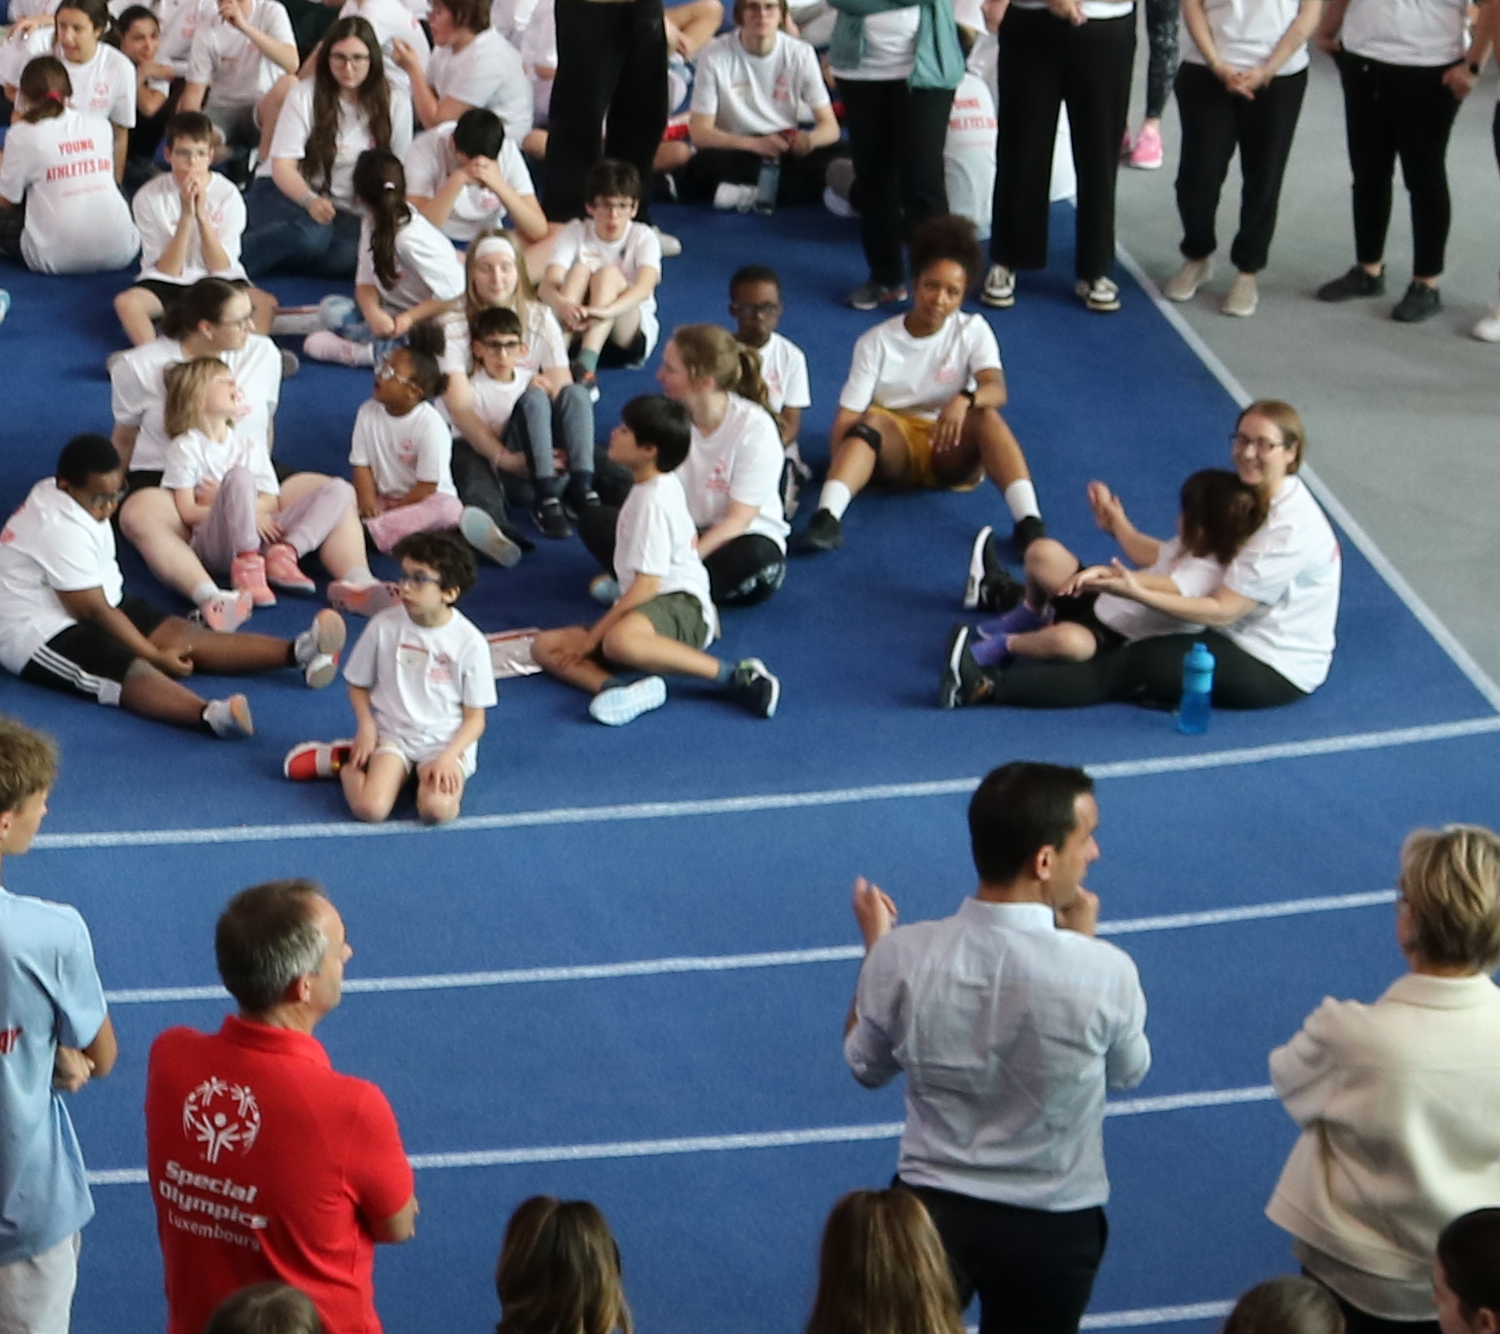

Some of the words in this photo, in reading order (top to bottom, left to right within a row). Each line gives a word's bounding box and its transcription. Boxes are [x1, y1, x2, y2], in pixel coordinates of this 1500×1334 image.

[166, 1160, 258, 1204] Special
[159, 1180, 268, 1229] Olympics
[168, 1211, 260, 1252] Luxembourg
